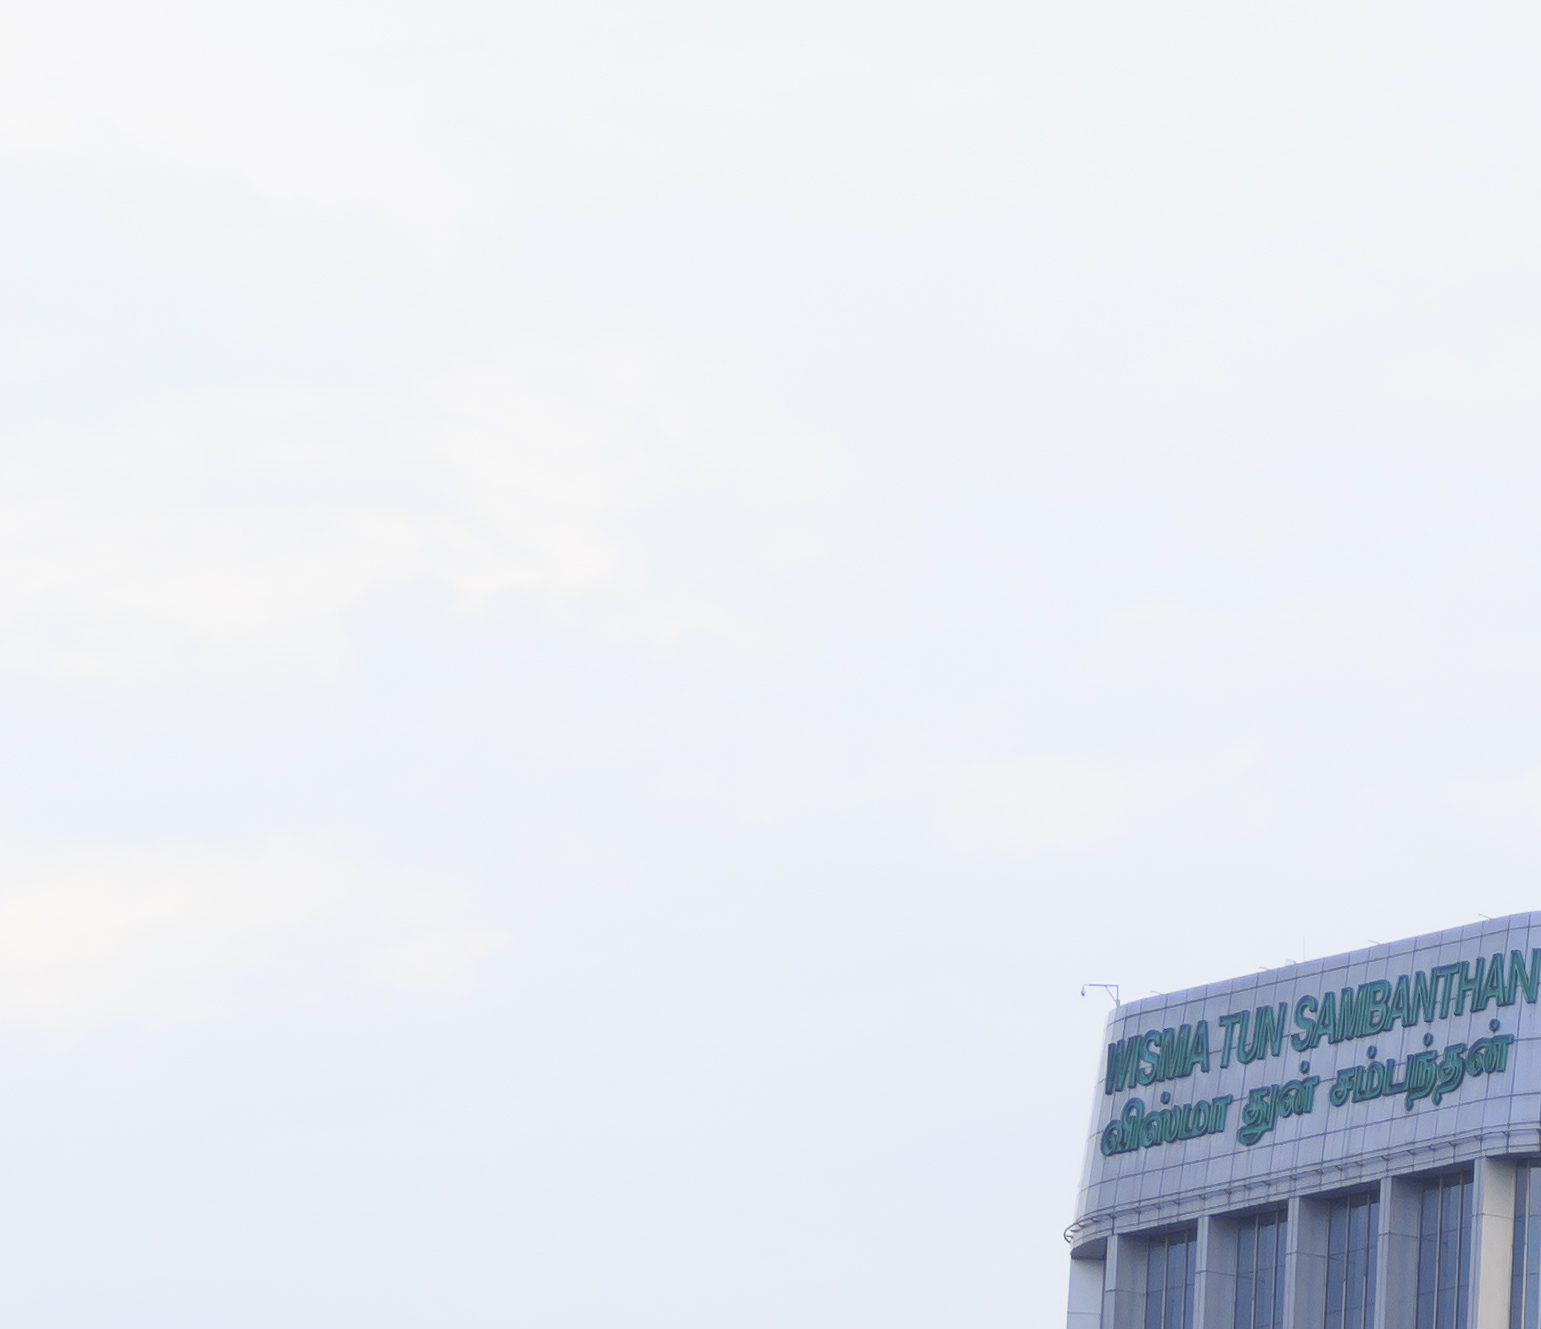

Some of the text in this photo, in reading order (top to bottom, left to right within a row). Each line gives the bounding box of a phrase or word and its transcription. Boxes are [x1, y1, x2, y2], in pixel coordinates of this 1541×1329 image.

[1105, 1019, 1210, 1095] WISMA
[1218, 1002, 1288, 1069] TUN
[1329, 1018, 1515, 1112] சம்பந்தன்
